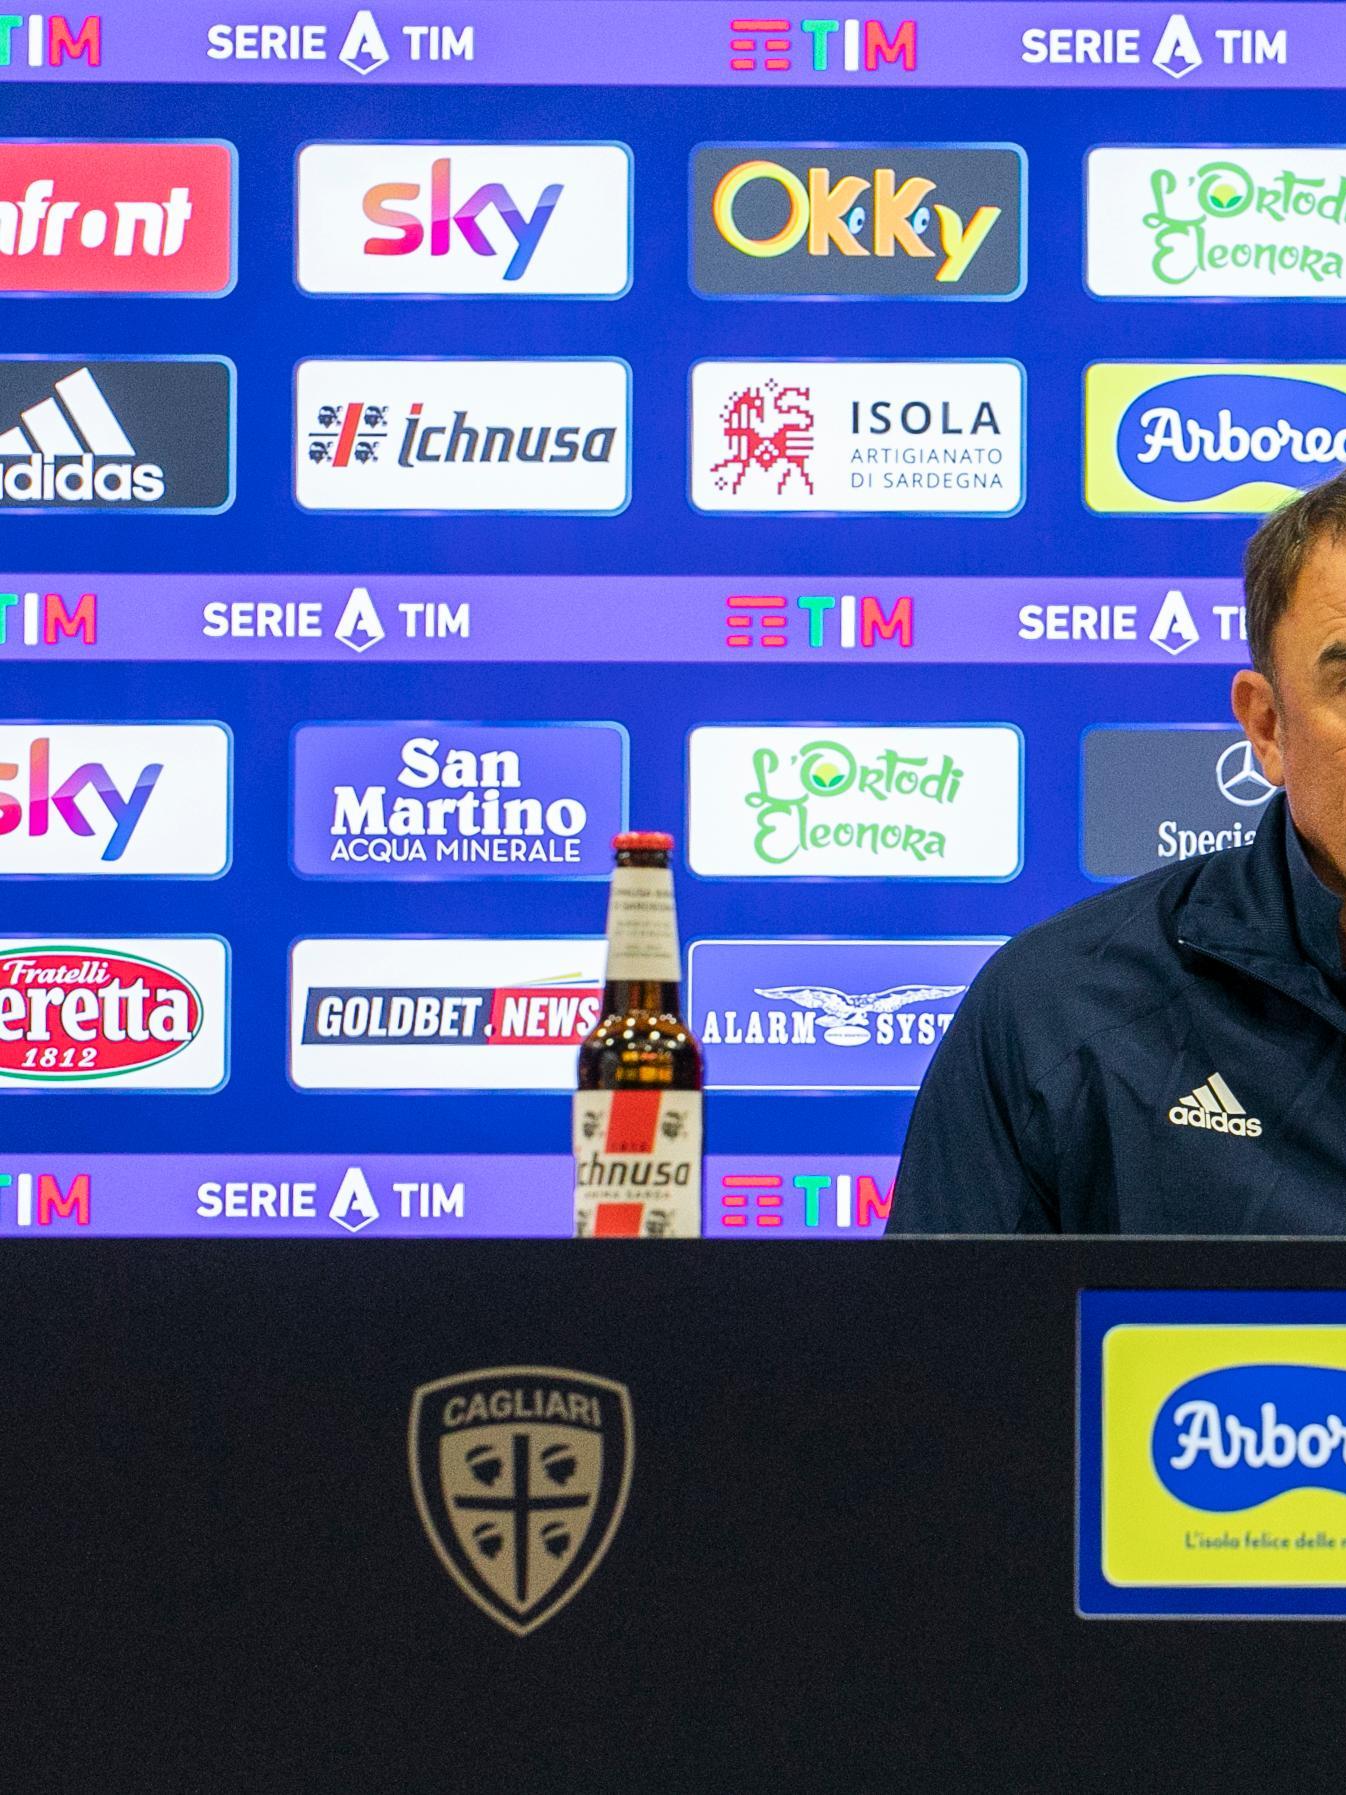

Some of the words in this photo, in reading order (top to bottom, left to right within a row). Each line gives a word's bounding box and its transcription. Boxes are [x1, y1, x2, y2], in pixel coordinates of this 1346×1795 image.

[206, 25, 327, 60] SERIE
[338, 10, 390, 75] A
[403, 26, 474, 60] TIM
[802, 19, 918, 71] TIM
[1021, 29, 1140, 64] SERIE
[1152, 14, 1203, 78] A
[1215, 30, 1287, 64] TIM
[362, 158, 564, 281] sky
[1152, 222, 1344, 285] Eleonora
[398, 403, 618, 468] ichnusa
[851, 400, 1002, 436] ISOLA
[0, 452, 165, 501] didas
[851, 448, 1003, 466] ARTIGIANATO
[851, 472, 870, 489] DI
[882, 471, 1003, 490] SARDEGNA
[202, 602, 323, 638] SERIE
[334, 587, 386, 653] A
[398, 602, 470, 638] TIM
[797, 595, 914, 648] TIM
[1018, 604, 1137, 641] SERIE
[1149, 590, 1200, 655] A
[1212, 606, 1247, 640] TI
[397, 737, 521, 789] San
[330, 786, 588, 836] Martino
[753, 798, 946, 865] Eleonora
[330, 838, 427, 864] ACQUA
[436, 838, 580, 863] MINERALE
[1158, 820, 1257, 861] Speci
[3, 960, 110, 985] Fratelli
[702, 1011, 816, 1044] ALARM
[876, 1013, 954, 1044] SYS
[21, 1047, 98, 1068] 1812
[1168, 1103, 1263, 1138] adidas
[577, 1151, 690, 1186] chnusa
[0, 1173, 91, 1227] IM
[196, 1182, 316, 1219] SERIE
[328, 1167, 380, 1233] A
[392, 1182, 465, 1219] TIM
[443, 1388, 602, 1428] CAGLIARI
[1245, 1532, 1290, 1550] felice
[1294, 1531, 1336, 1550] delle
